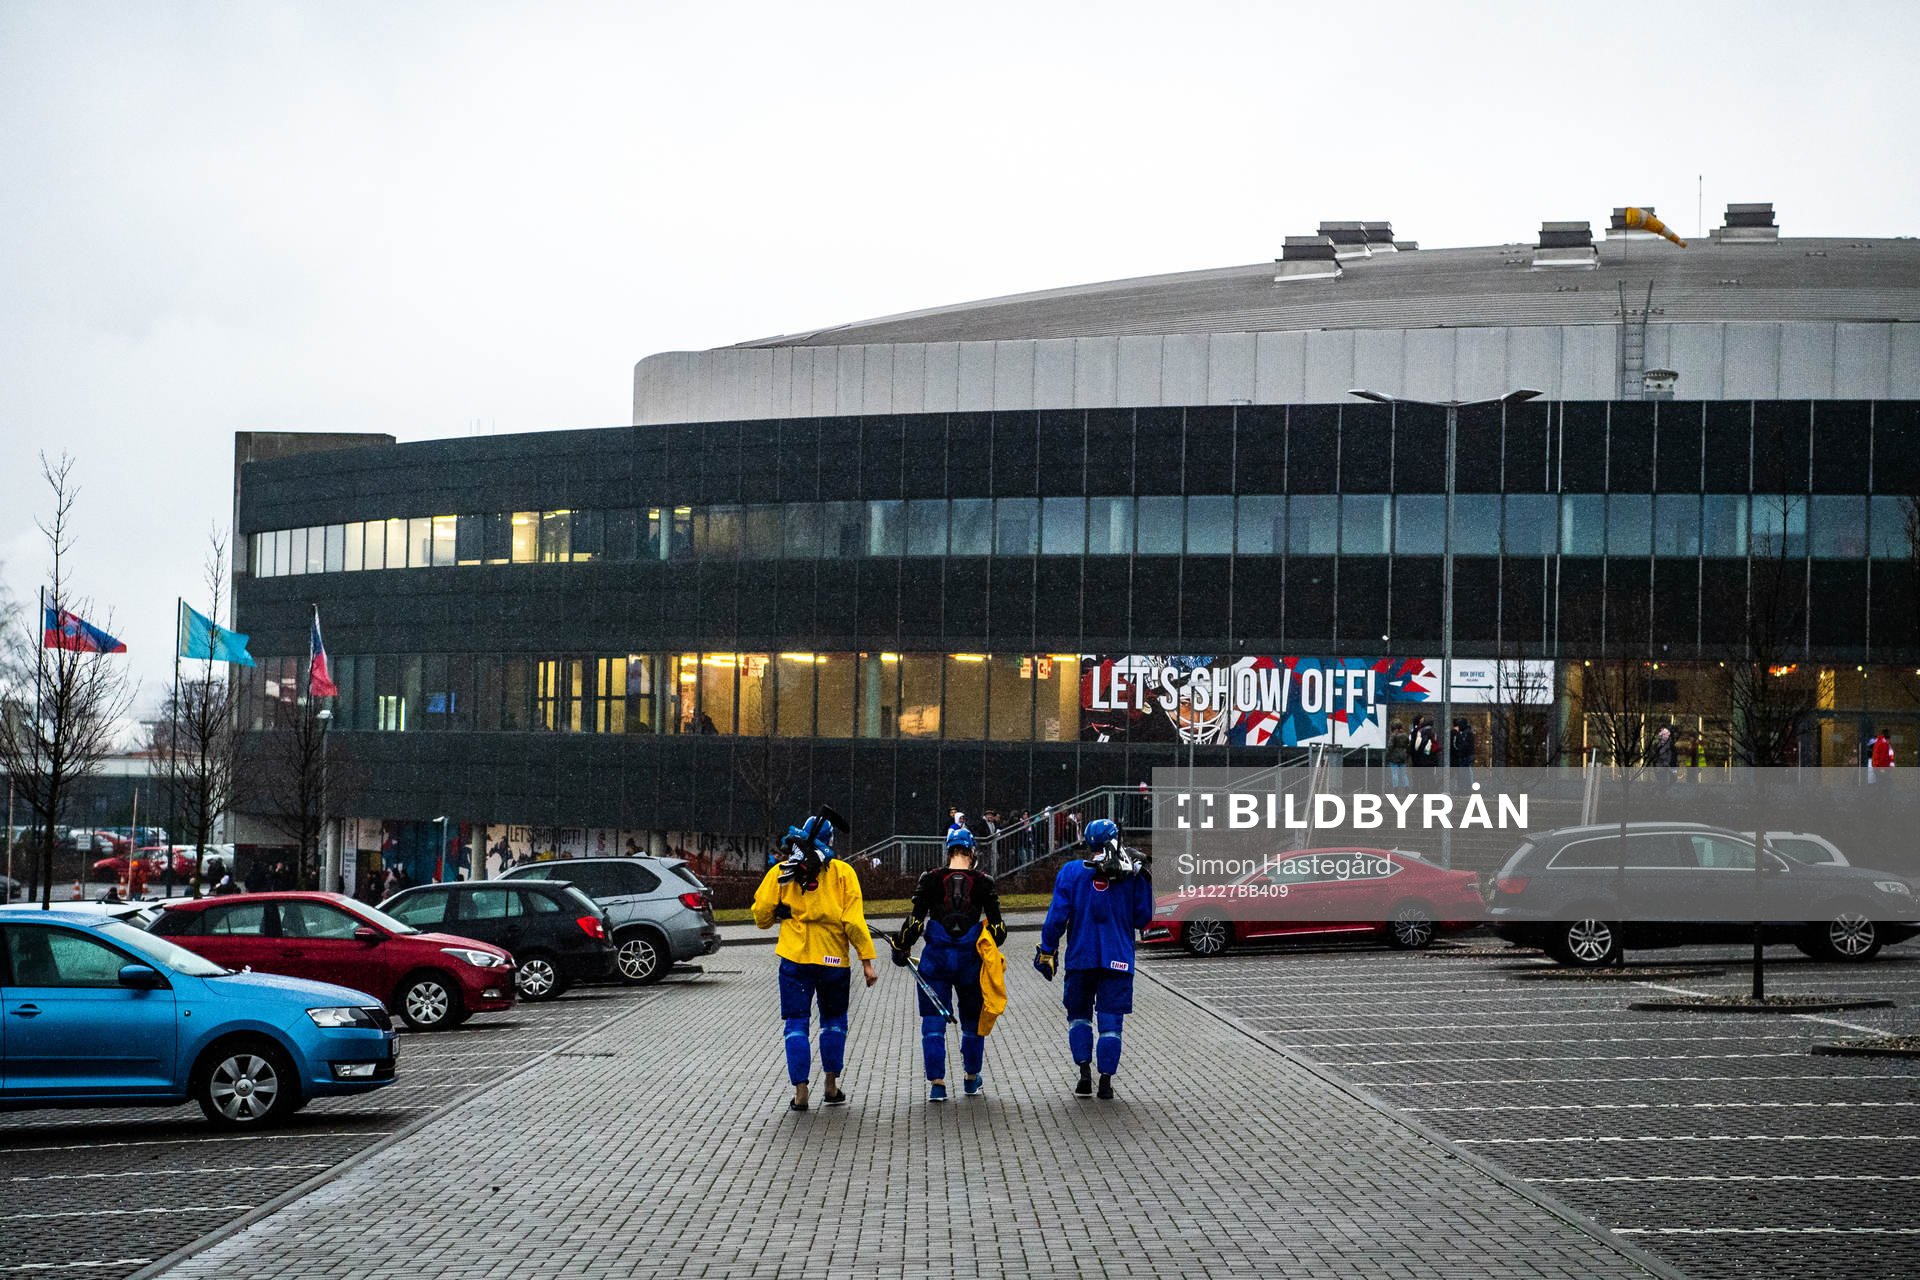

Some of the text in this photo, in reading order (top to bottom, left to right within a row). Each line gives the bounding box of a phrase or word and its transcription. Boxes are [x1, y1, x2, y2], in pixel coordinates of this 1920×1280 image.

[1092, 665, 1376, 714] LET'S SHOW OFF!
